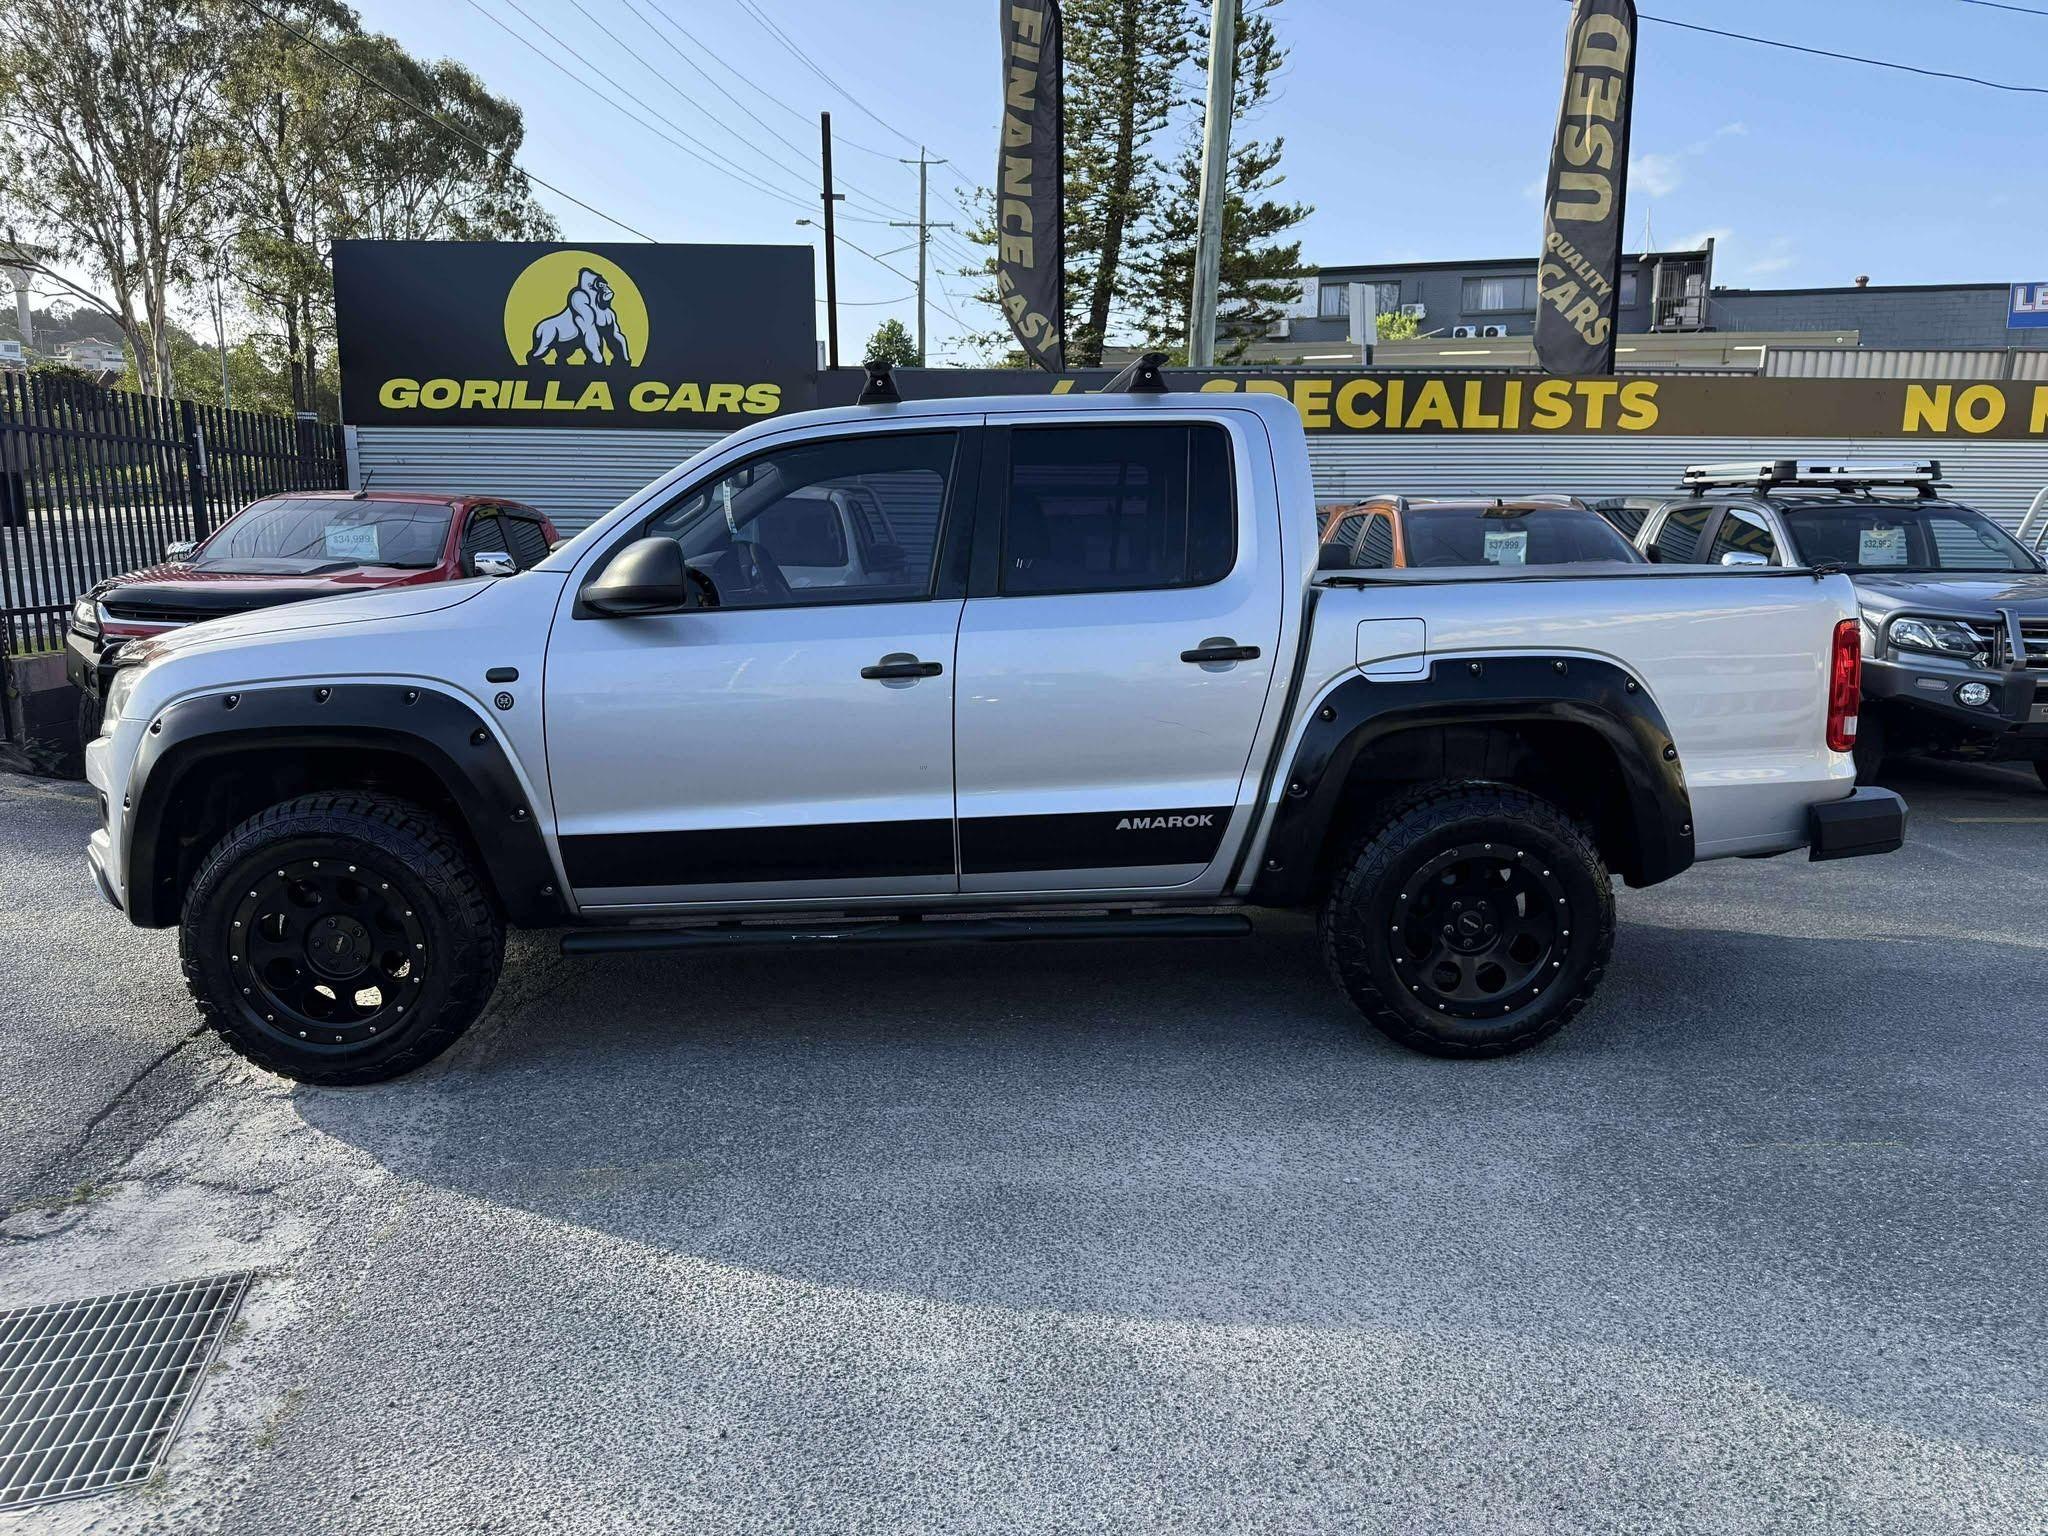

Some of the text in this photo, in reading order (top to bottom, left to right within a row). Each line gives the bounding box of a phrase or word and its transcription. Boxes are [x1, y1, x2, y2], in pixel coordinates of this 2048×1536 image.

[1002, 11, 1043, 269] FINANCE
[1555, 13, 1632, 222] USED
[1547, 232, 1613, 298] QUALITY
[999, 269, 1061, 352] EASY
[1538, 263, 1612, 346] CARS
[379, 379, 781, 414] GORILLA CARS
[1200, 378, 1659, 430] ECIALISTS
[1902, 384, 2006, 433] NO
[1116, 814, 1214, 830] AMAROK
